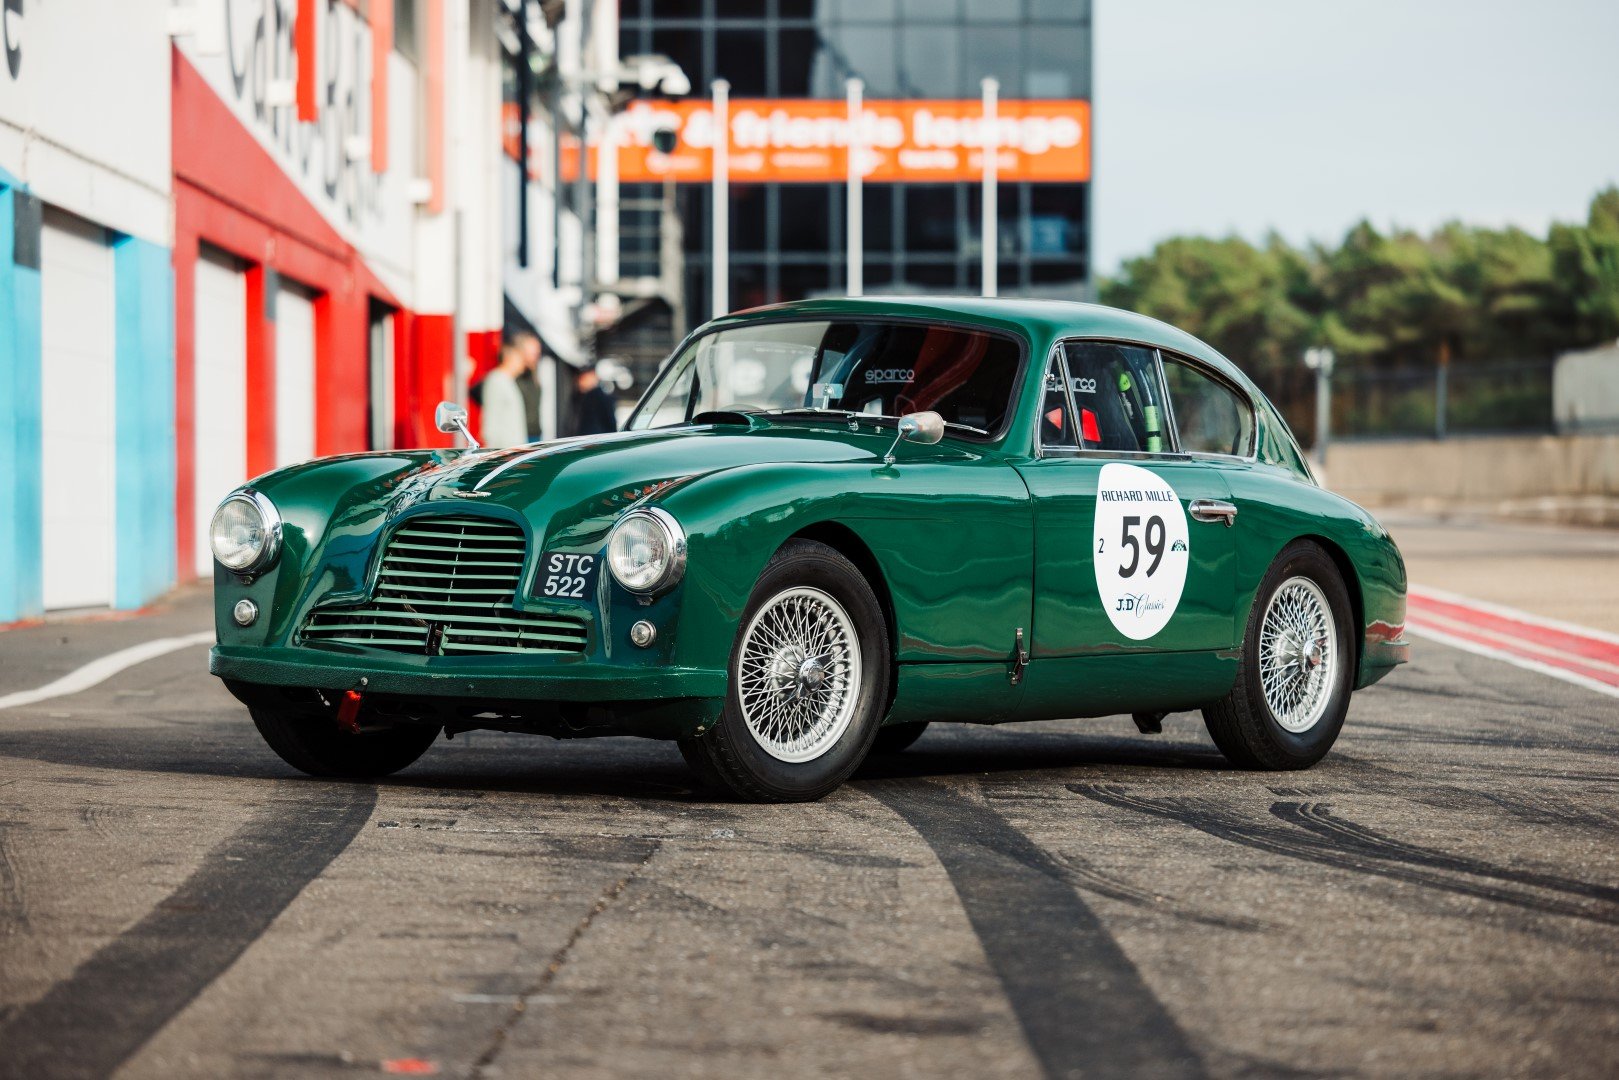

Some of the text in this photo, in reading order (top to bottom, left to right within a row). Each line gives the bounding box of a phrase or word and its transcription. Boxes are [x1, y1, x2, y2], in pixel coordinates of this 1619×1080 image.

[731, 109, 904, 149] friends
[913, 109, 1082, 155] lounge
[865, 369, 915, 384] sparco
[1046, 376, 1096, 393] sprco
[1101, 490, 1174, 502] RICHARD MILLE
[1098, 538, 1104, 553] 2
[1118, 515, 1166, 578] 59
[548, 554, 594, 575] STC
[544, 575, 586, 598] 522
